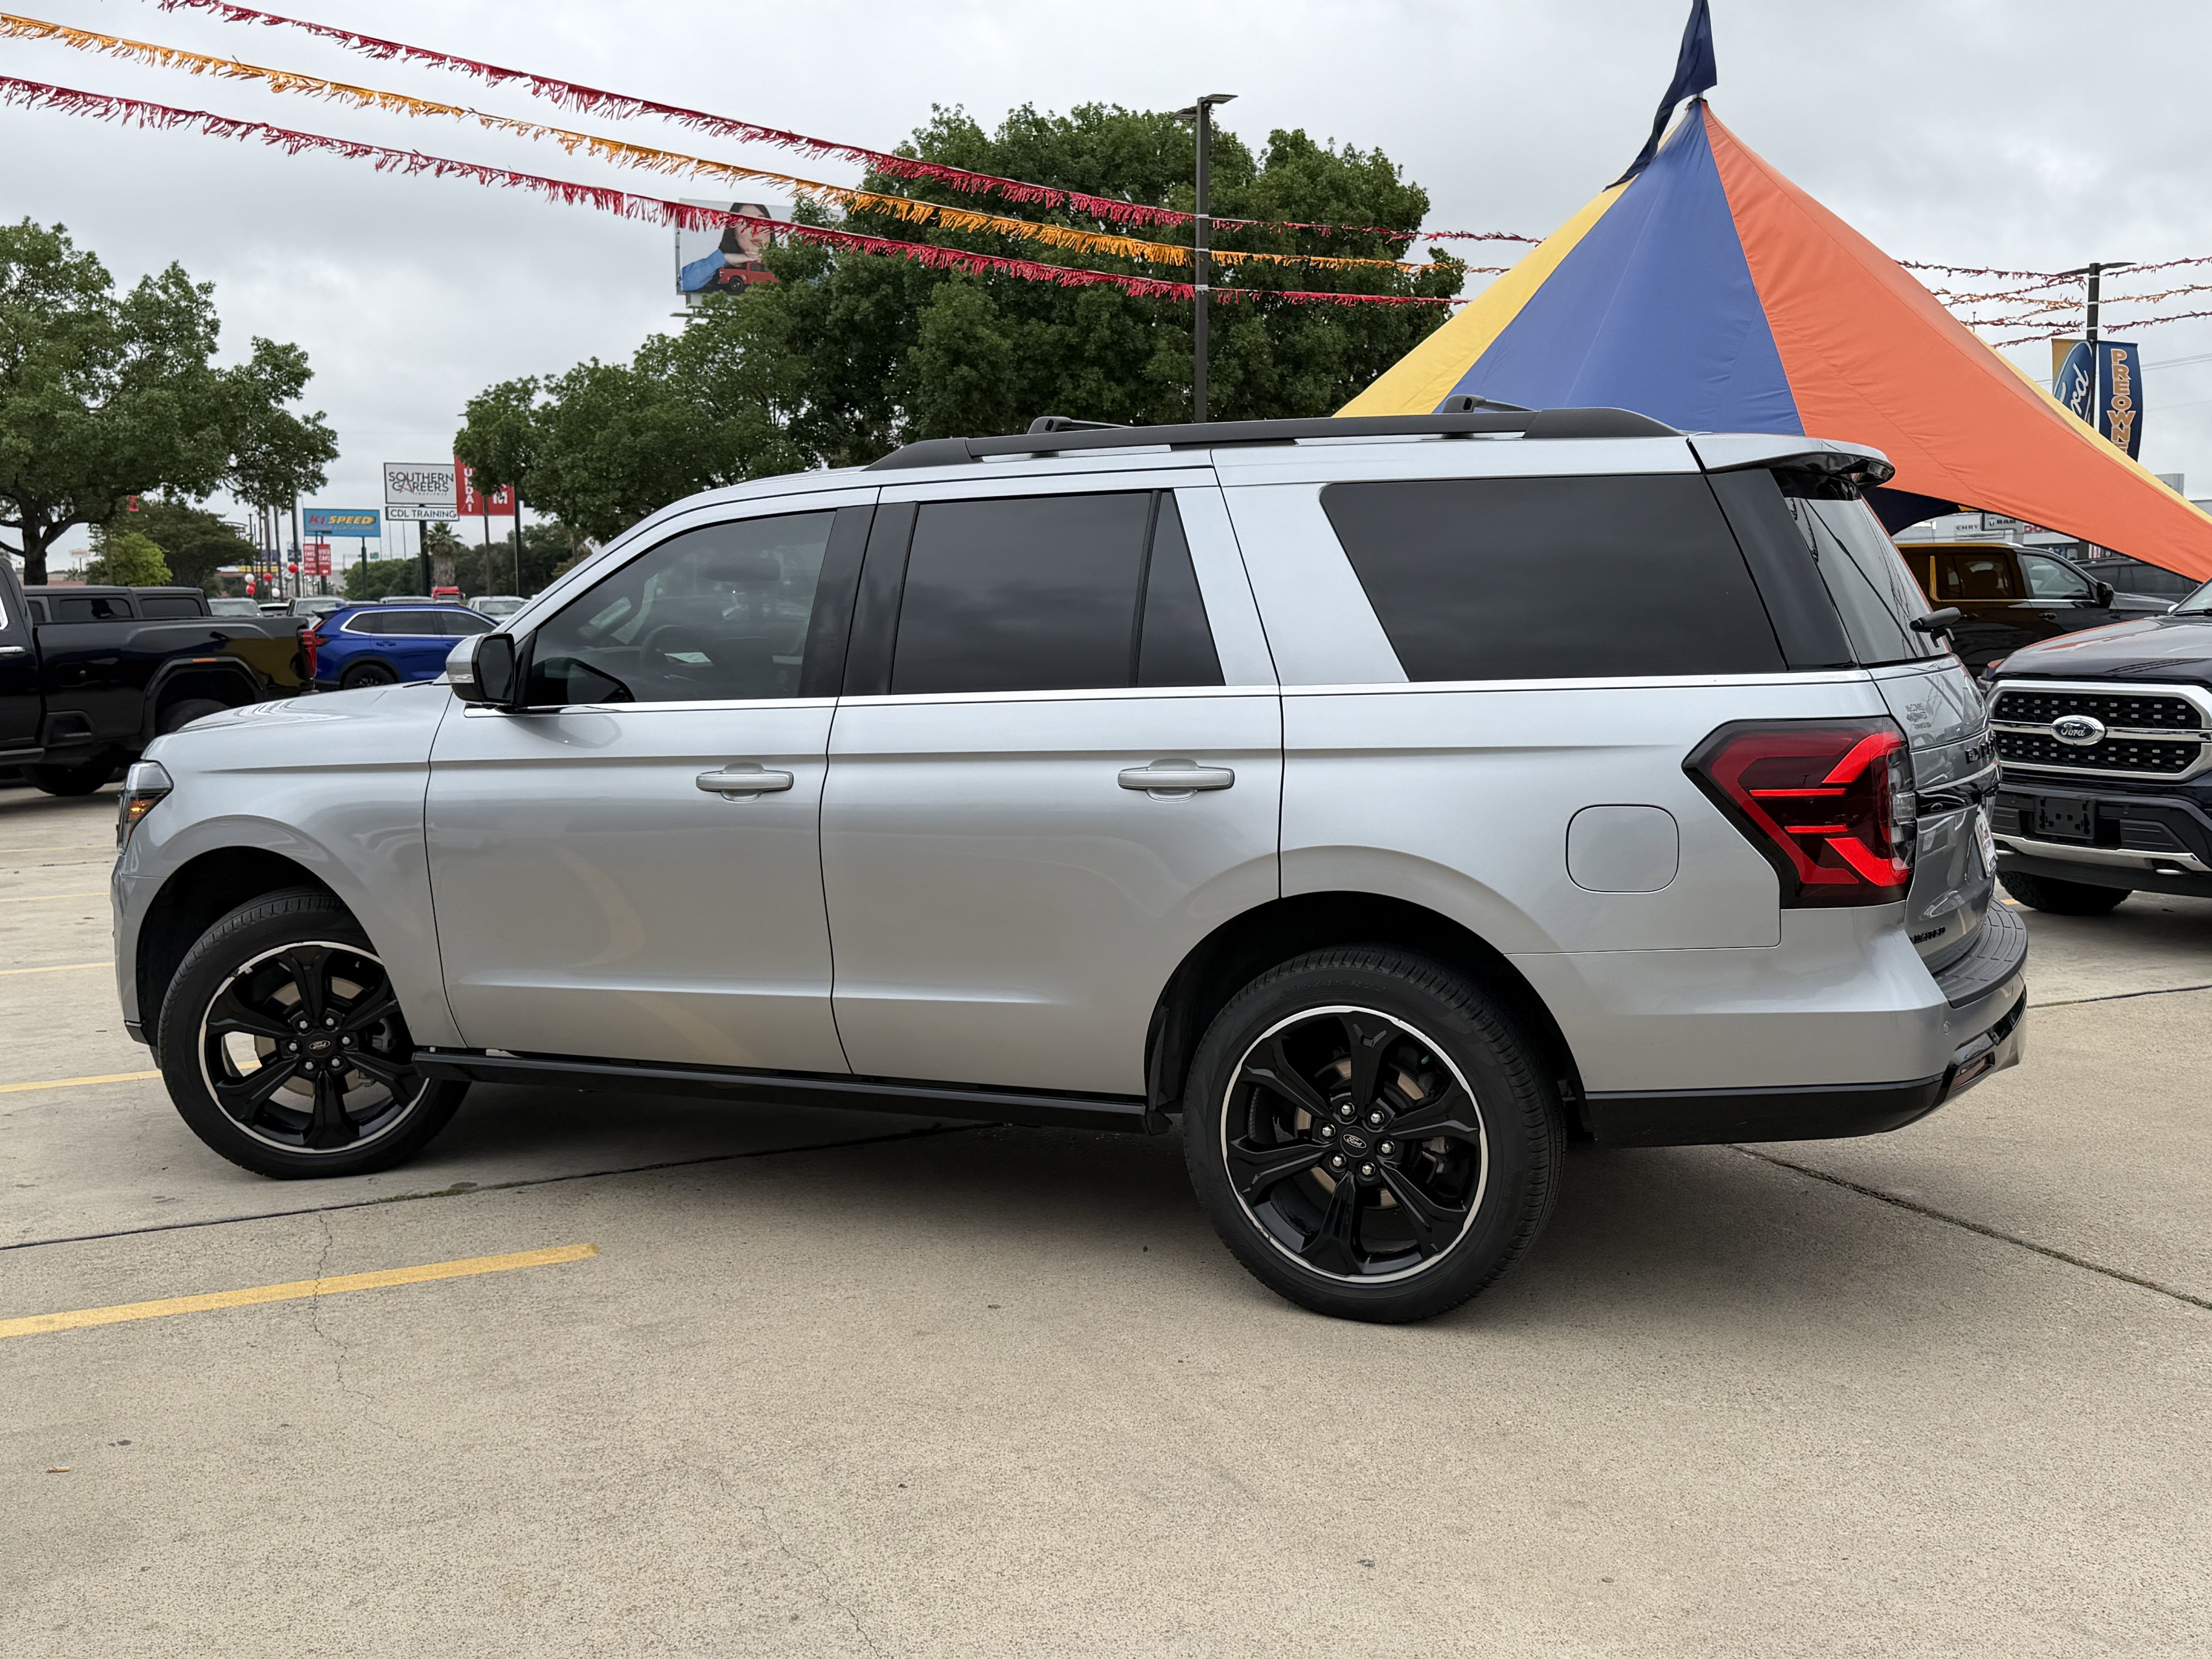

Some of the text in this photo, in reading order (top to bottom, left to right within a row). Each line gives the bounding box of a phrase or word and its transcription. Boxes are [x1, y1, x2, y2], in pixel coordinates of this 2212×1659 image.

[389, 472, 454, 483] SOUTHERN
[392, 478, 449, 493] CAREERS
[390, 509, 456, 518] CDL TRAINING
[328, 515, 376, 524] SPEED
[2061, 722, 2086, 736] Ford
